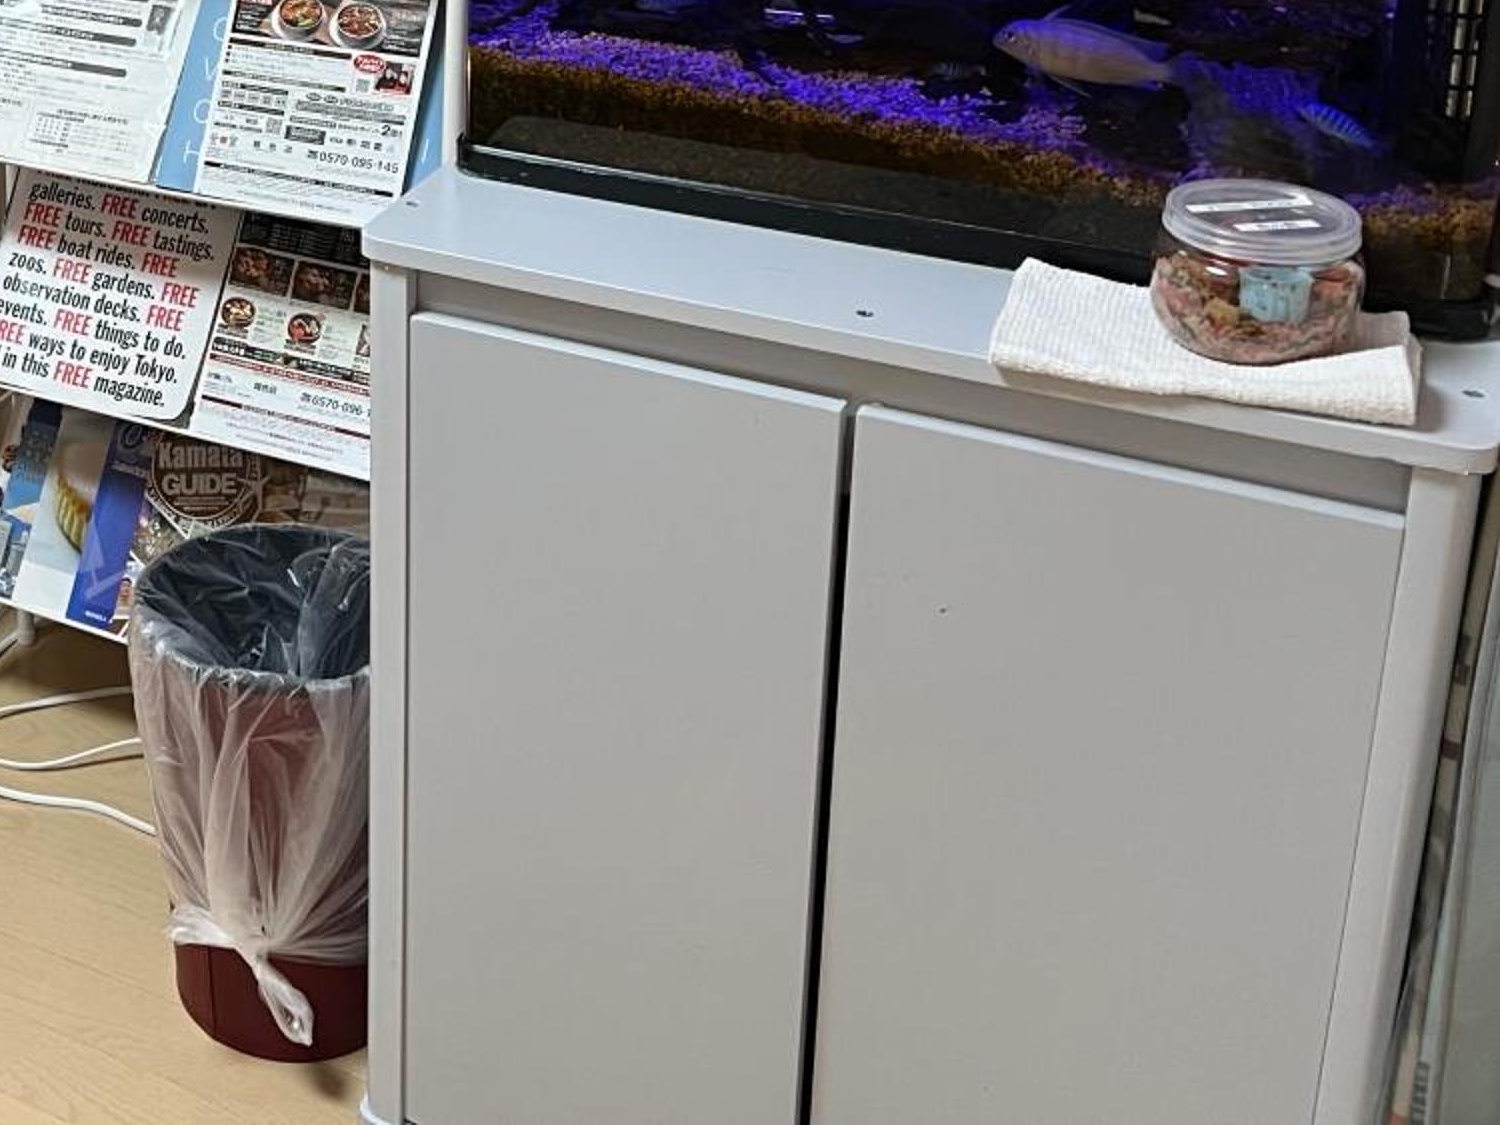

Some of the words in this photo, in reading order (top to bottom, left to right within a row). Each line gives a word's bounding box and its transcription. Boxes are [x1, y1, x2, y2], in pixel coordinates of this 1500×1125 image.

[24, 202, 66, 229] FREE
[65, 212, 106, 238] tours.
[111, 220, 155, 247] FREE
[153, 233, 215, 262] tastings.
[29, 181, 95, 211] galleries.
[101, 193, 139, 218] FREE
[141, 206, 209, 234] concerts.
[17, 225, 59, 251] FREE
[58, 235, 92, 260] boat
[96, 246, 135, 270] rides.
[141, 252, 180, 278] FREE
[3, 274, 90, 310] observation
[94, 295, 141, 323] decks.
[146, 305, 185, 332] FREE
[9, 252, 47, 275] zoos.
[53, 257, 93, 284] FREE
[92, 271, 156, 300] gardens.
[161, 282, 199, 309] FREE
[29, 331, 65, 356] ways
[71, 339, 85, 361] to
[90, 349, 130, 376] enjoy
[136, 355, 178, 384] Tokyo.
[54, 308, 93, 336] FREE
[95, 320, 139, 350] things
[144, 331, 159, 352] to
[164, 338, 186, 360] do.
[3, 346, 16, 368] in
[21, 353, 50, 377] this
[53, 360, 93, 388] FREE
[93, 376, 165, 407] magazine.
[158, 442, 244, 469] Kamata
[161, 472, 238, 496] GUIDE
